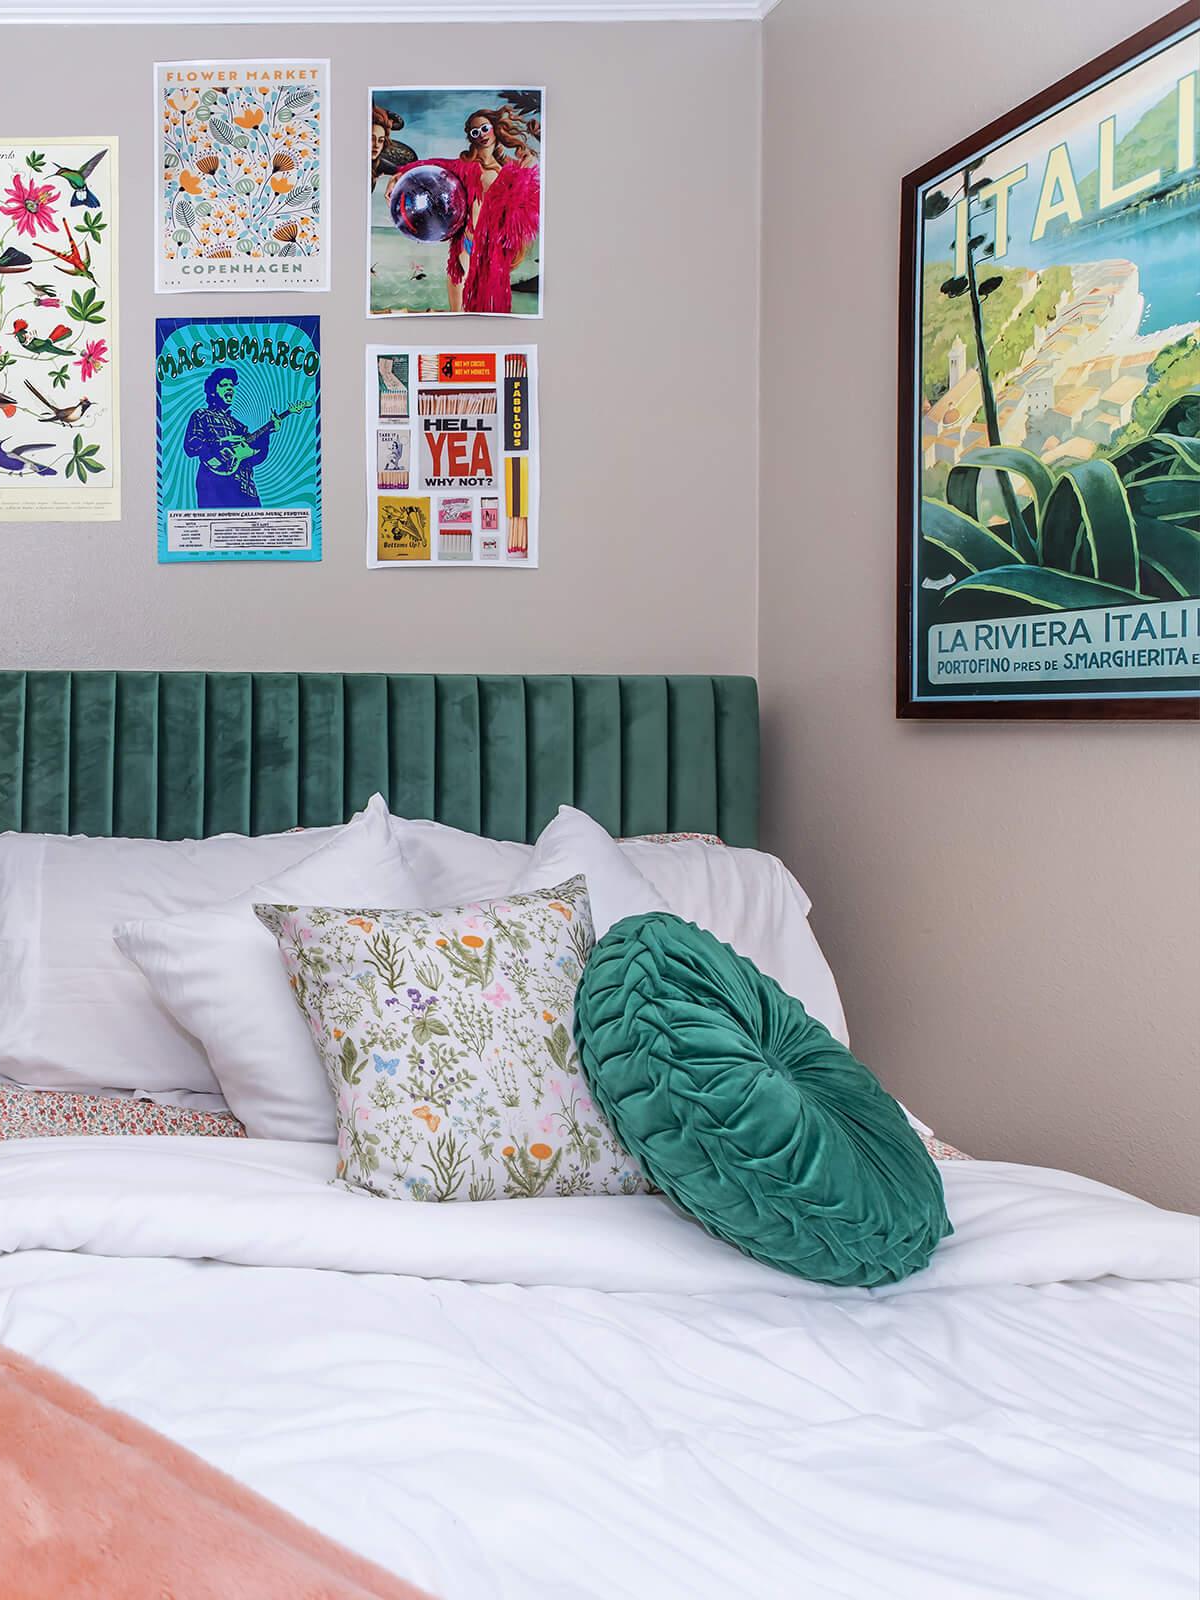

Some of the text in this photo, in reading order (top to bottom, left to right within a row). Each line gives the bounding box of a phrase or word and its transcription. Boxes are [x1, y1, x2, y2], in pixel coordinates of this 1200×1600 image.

[166, 69, 319, 82] FLOWER MARKET
[182, 263, 303, 275] COPENHAGEN
[157, 342, 206, 381] MAC
[423, 419, 492, 431] HELL
[512, 382, 521, 447] FABULOUS
[425, 432, 493, 477] YEA
[425, 478, 493, 486] WHY NOT?
[938, 629, 968, 653] LA
[975, 618, 1092, 651] RIVIERA
[937, 657, 1010, 675] PORTOFINO
[1014, 661, 1041, 672] PRES
[1044, 660, 1058, 670] DE
[1063, 647, 1189, 670] S.MARGHERITA
